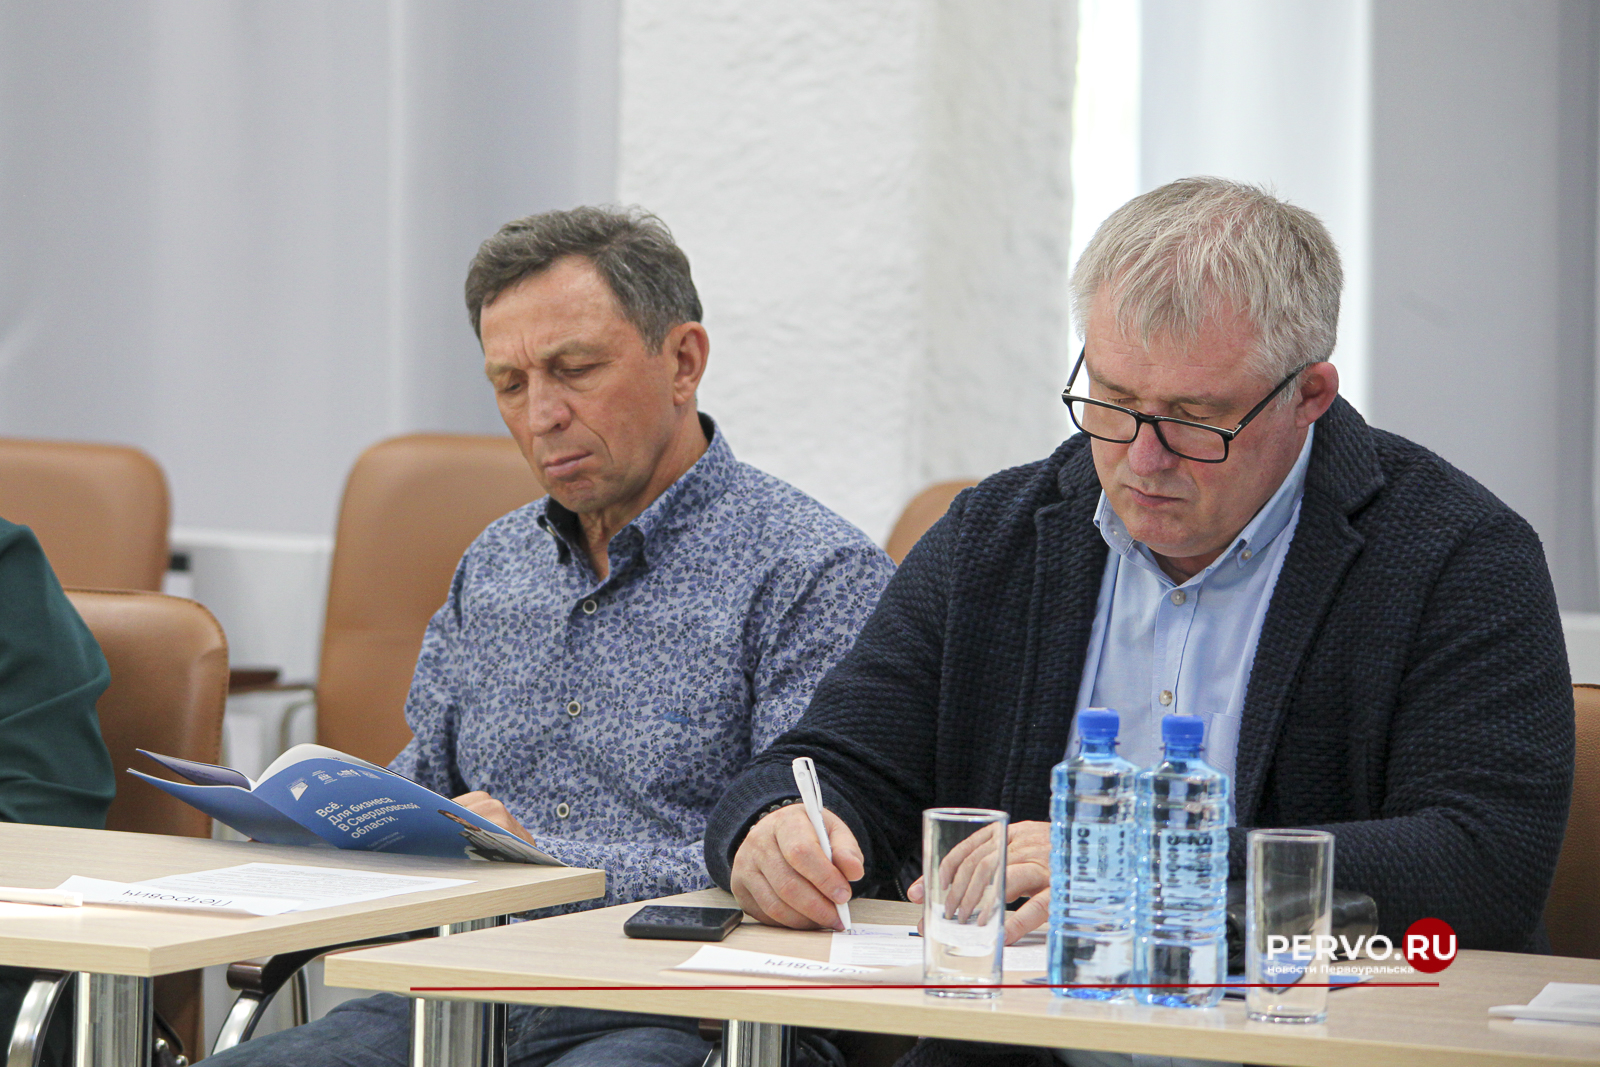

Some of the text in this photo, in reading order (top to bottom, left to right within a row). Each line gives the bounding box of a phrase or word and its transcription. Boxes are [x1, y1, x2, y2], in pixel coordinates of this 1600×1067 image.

[315, 801, 344, 818] Всё.
[327, 796, 397, 826] Для бизнеса.
[346, 802, 421, 826] Свердловской
[351, 815, 399, 839] области.
[122, 889, 233, 907] Петрович
